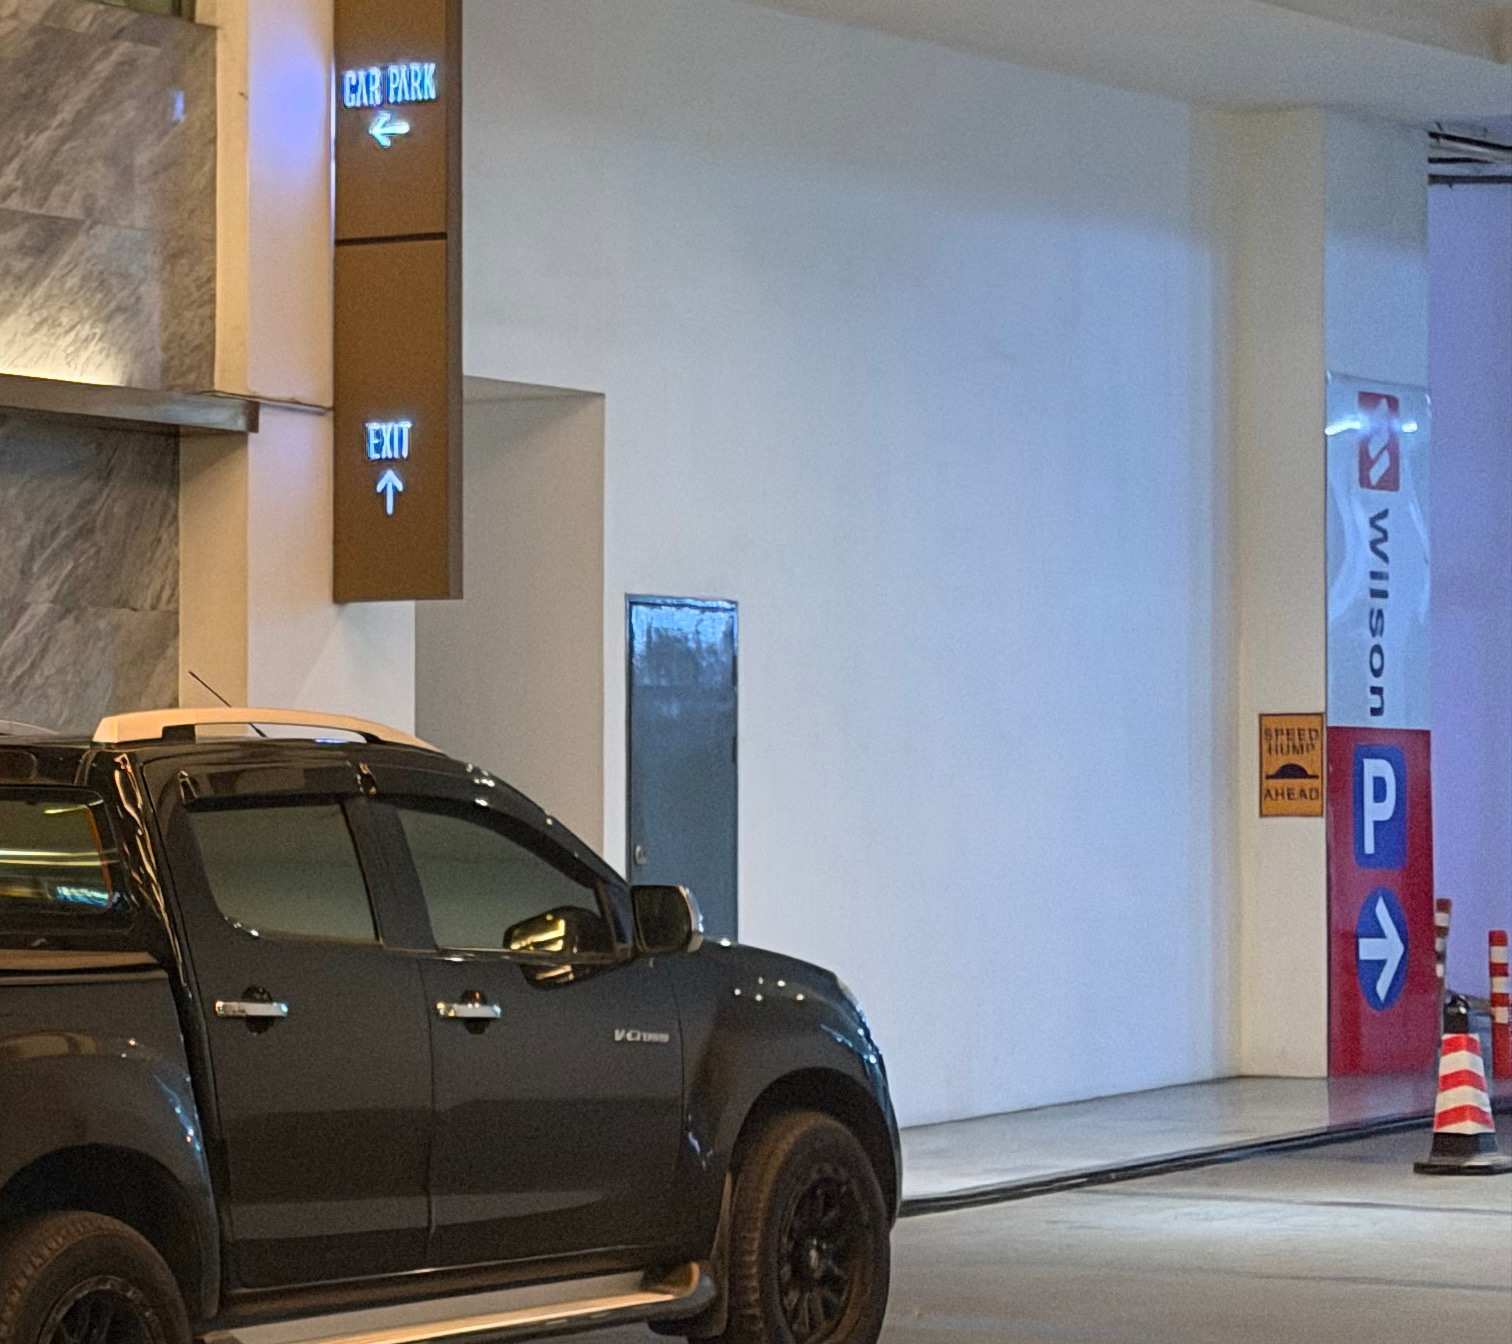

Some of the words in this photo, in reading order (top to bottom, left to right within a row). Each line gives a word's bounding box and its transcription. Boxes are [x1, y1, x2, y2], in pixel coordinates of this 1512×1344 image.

[344, 67, 383, 108] CAR
[388, 62, 437, 104] PARK
[365, 421, 412, 460] EXIT
[1264, 727, 1319, 742] SPEED
[1267, 743, 1316, 756] HUMP
[1263, 787, 1319, 801] AHEAD
[1362, 757, 1397, 856] P
